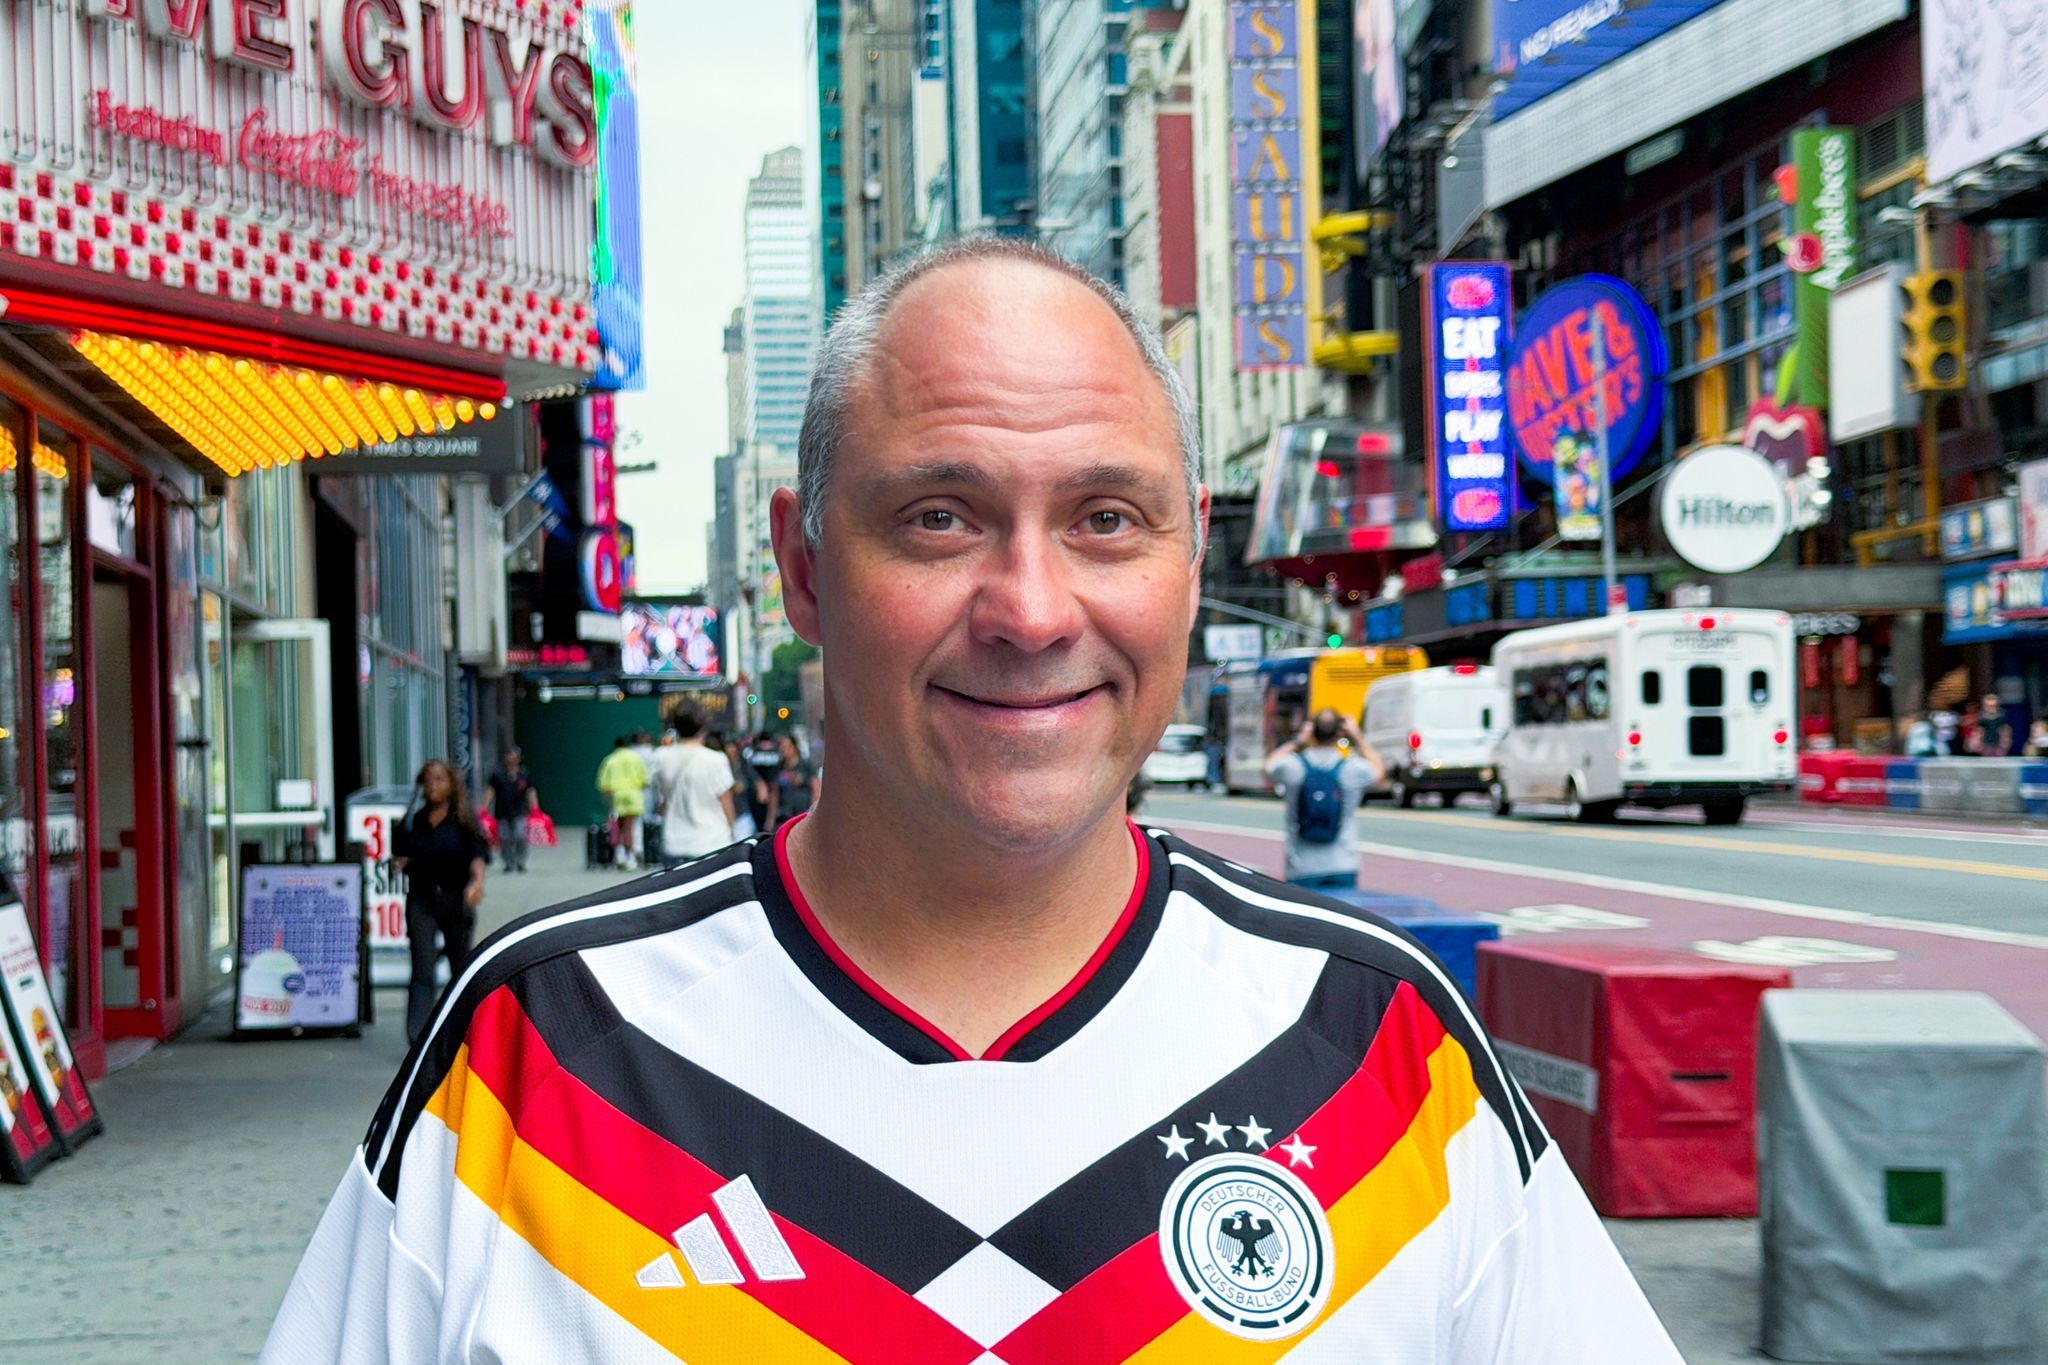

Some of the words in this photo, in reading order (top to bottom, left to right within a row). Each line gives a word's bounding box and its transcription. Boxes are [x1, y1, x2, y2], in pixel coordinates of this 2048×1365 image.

[328, 0, 598, 168] GUYS
[1442, 316, 1501, 360] EAT
[1678, 496, 1776, 525] Hilton
[363, 815, 383, 861] 3
[1200, 1184, 1286, 1214] DEUTSCHER
[1202, 1263, 1302, 1308] FUSSBALL-BUND
